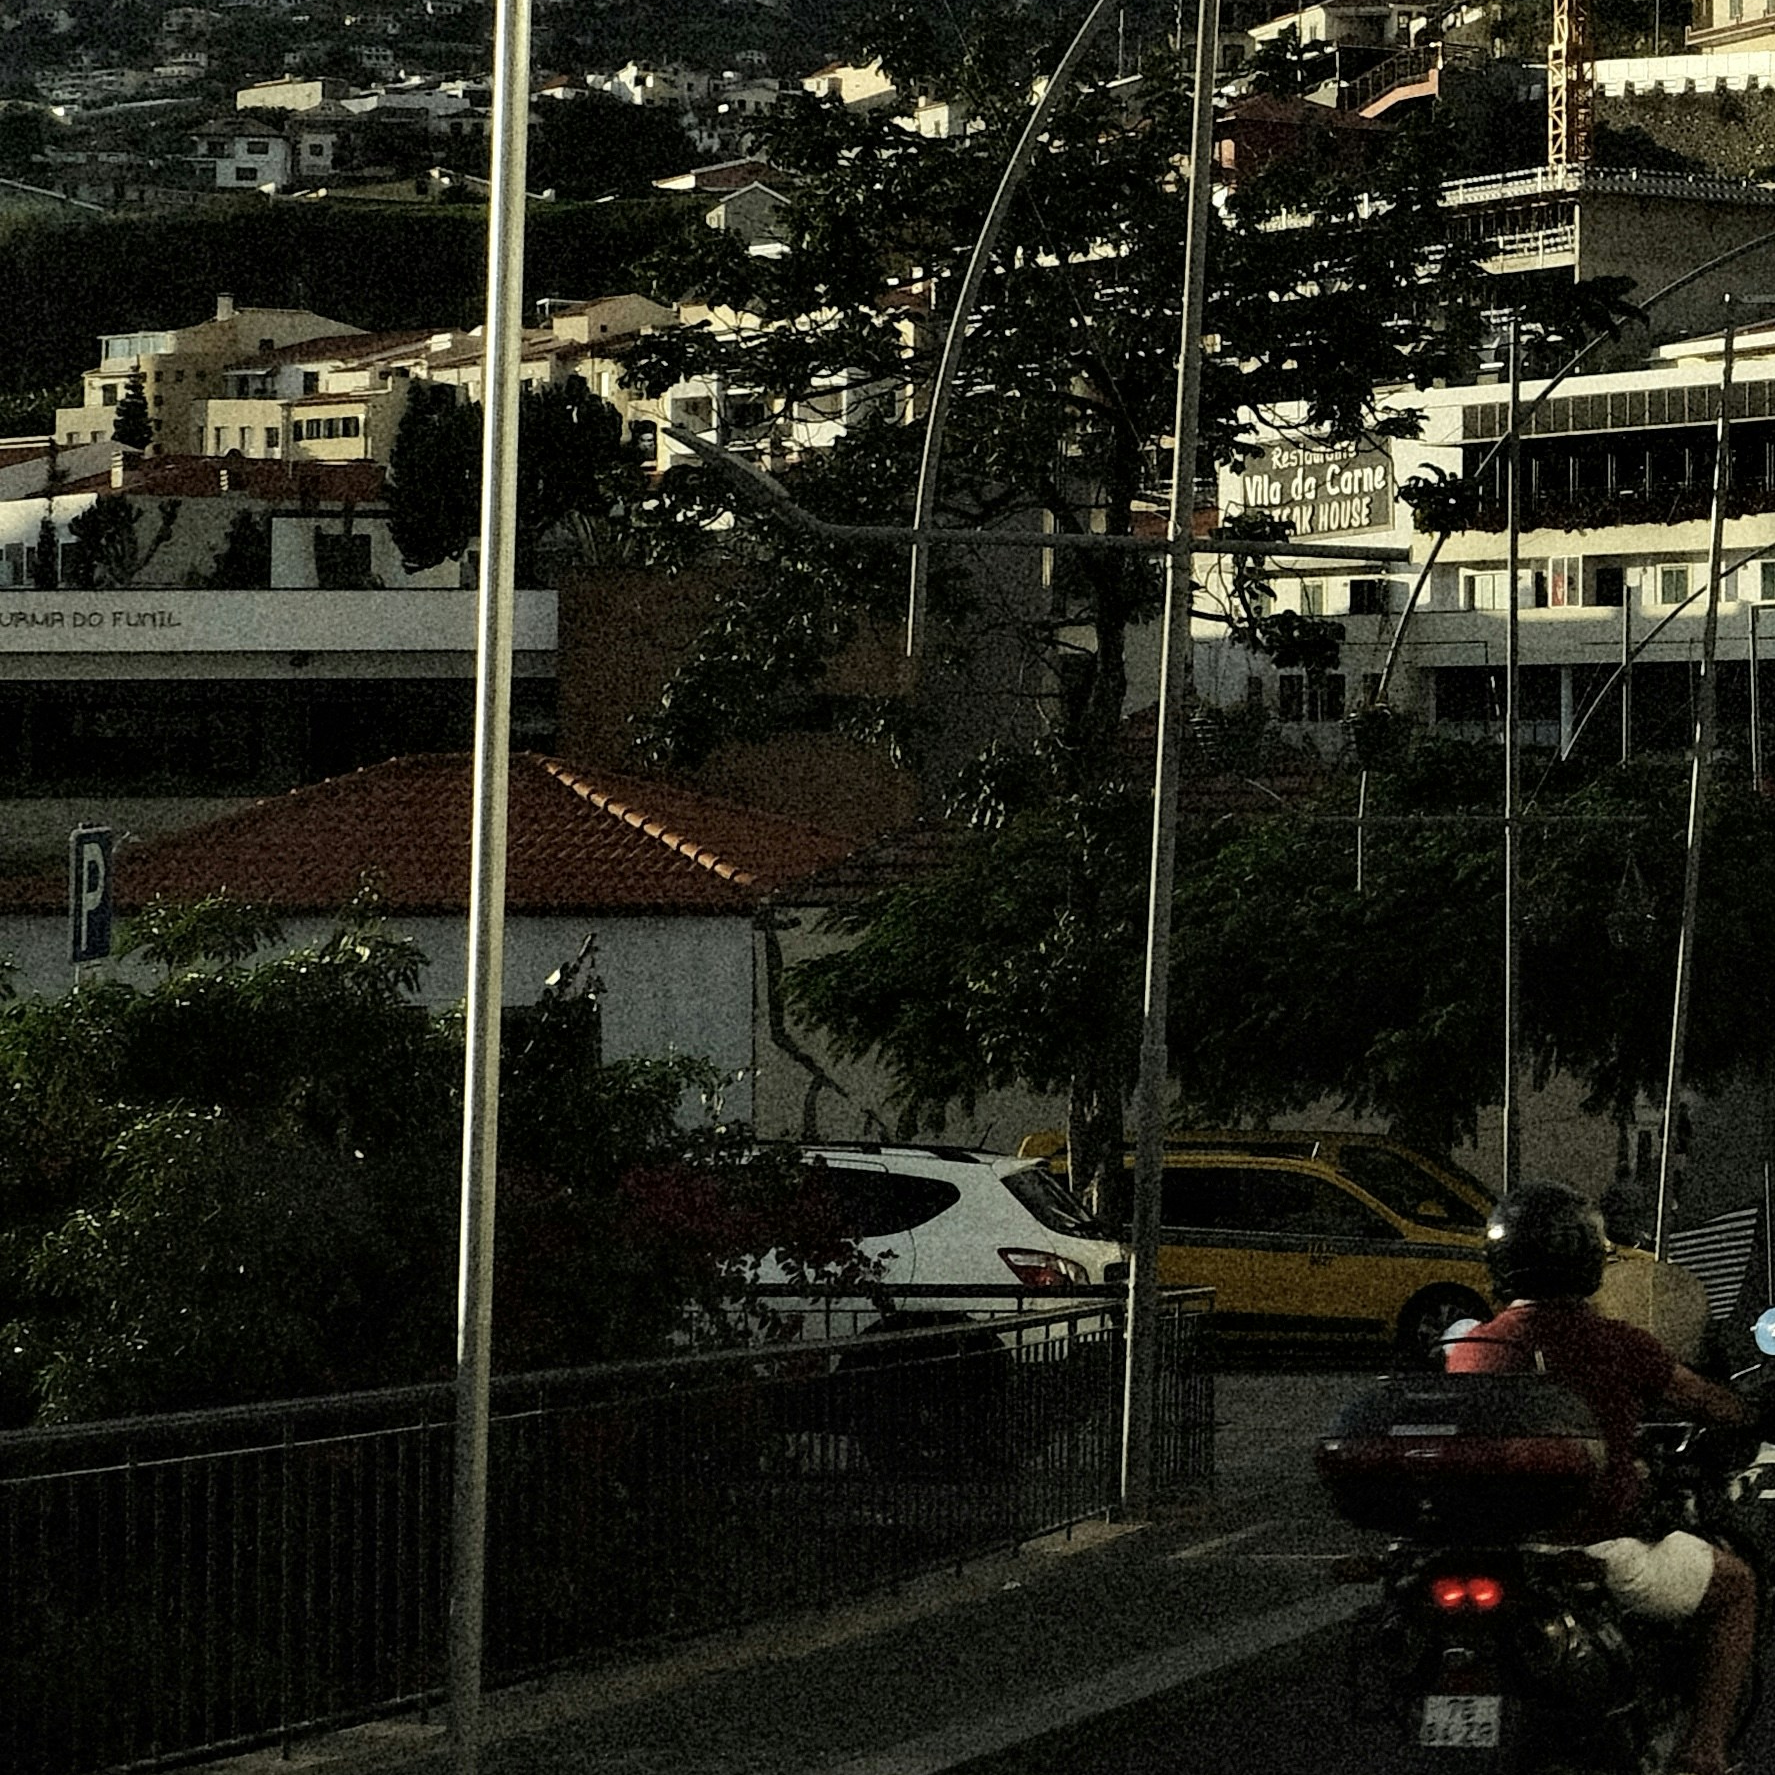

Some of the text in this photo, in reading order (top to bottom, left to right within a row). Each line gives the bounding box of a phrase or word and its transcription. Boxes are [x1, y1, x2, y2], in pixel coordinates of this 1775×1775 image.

[1244, 464, 1386, 506] Vila da Carne
[1319, 496, 1371, 531] HOUSE
[73, 611, 103, 628] DO
[112, 610, 181, 628] FUNIL
[82, 843, 105, 952] P
